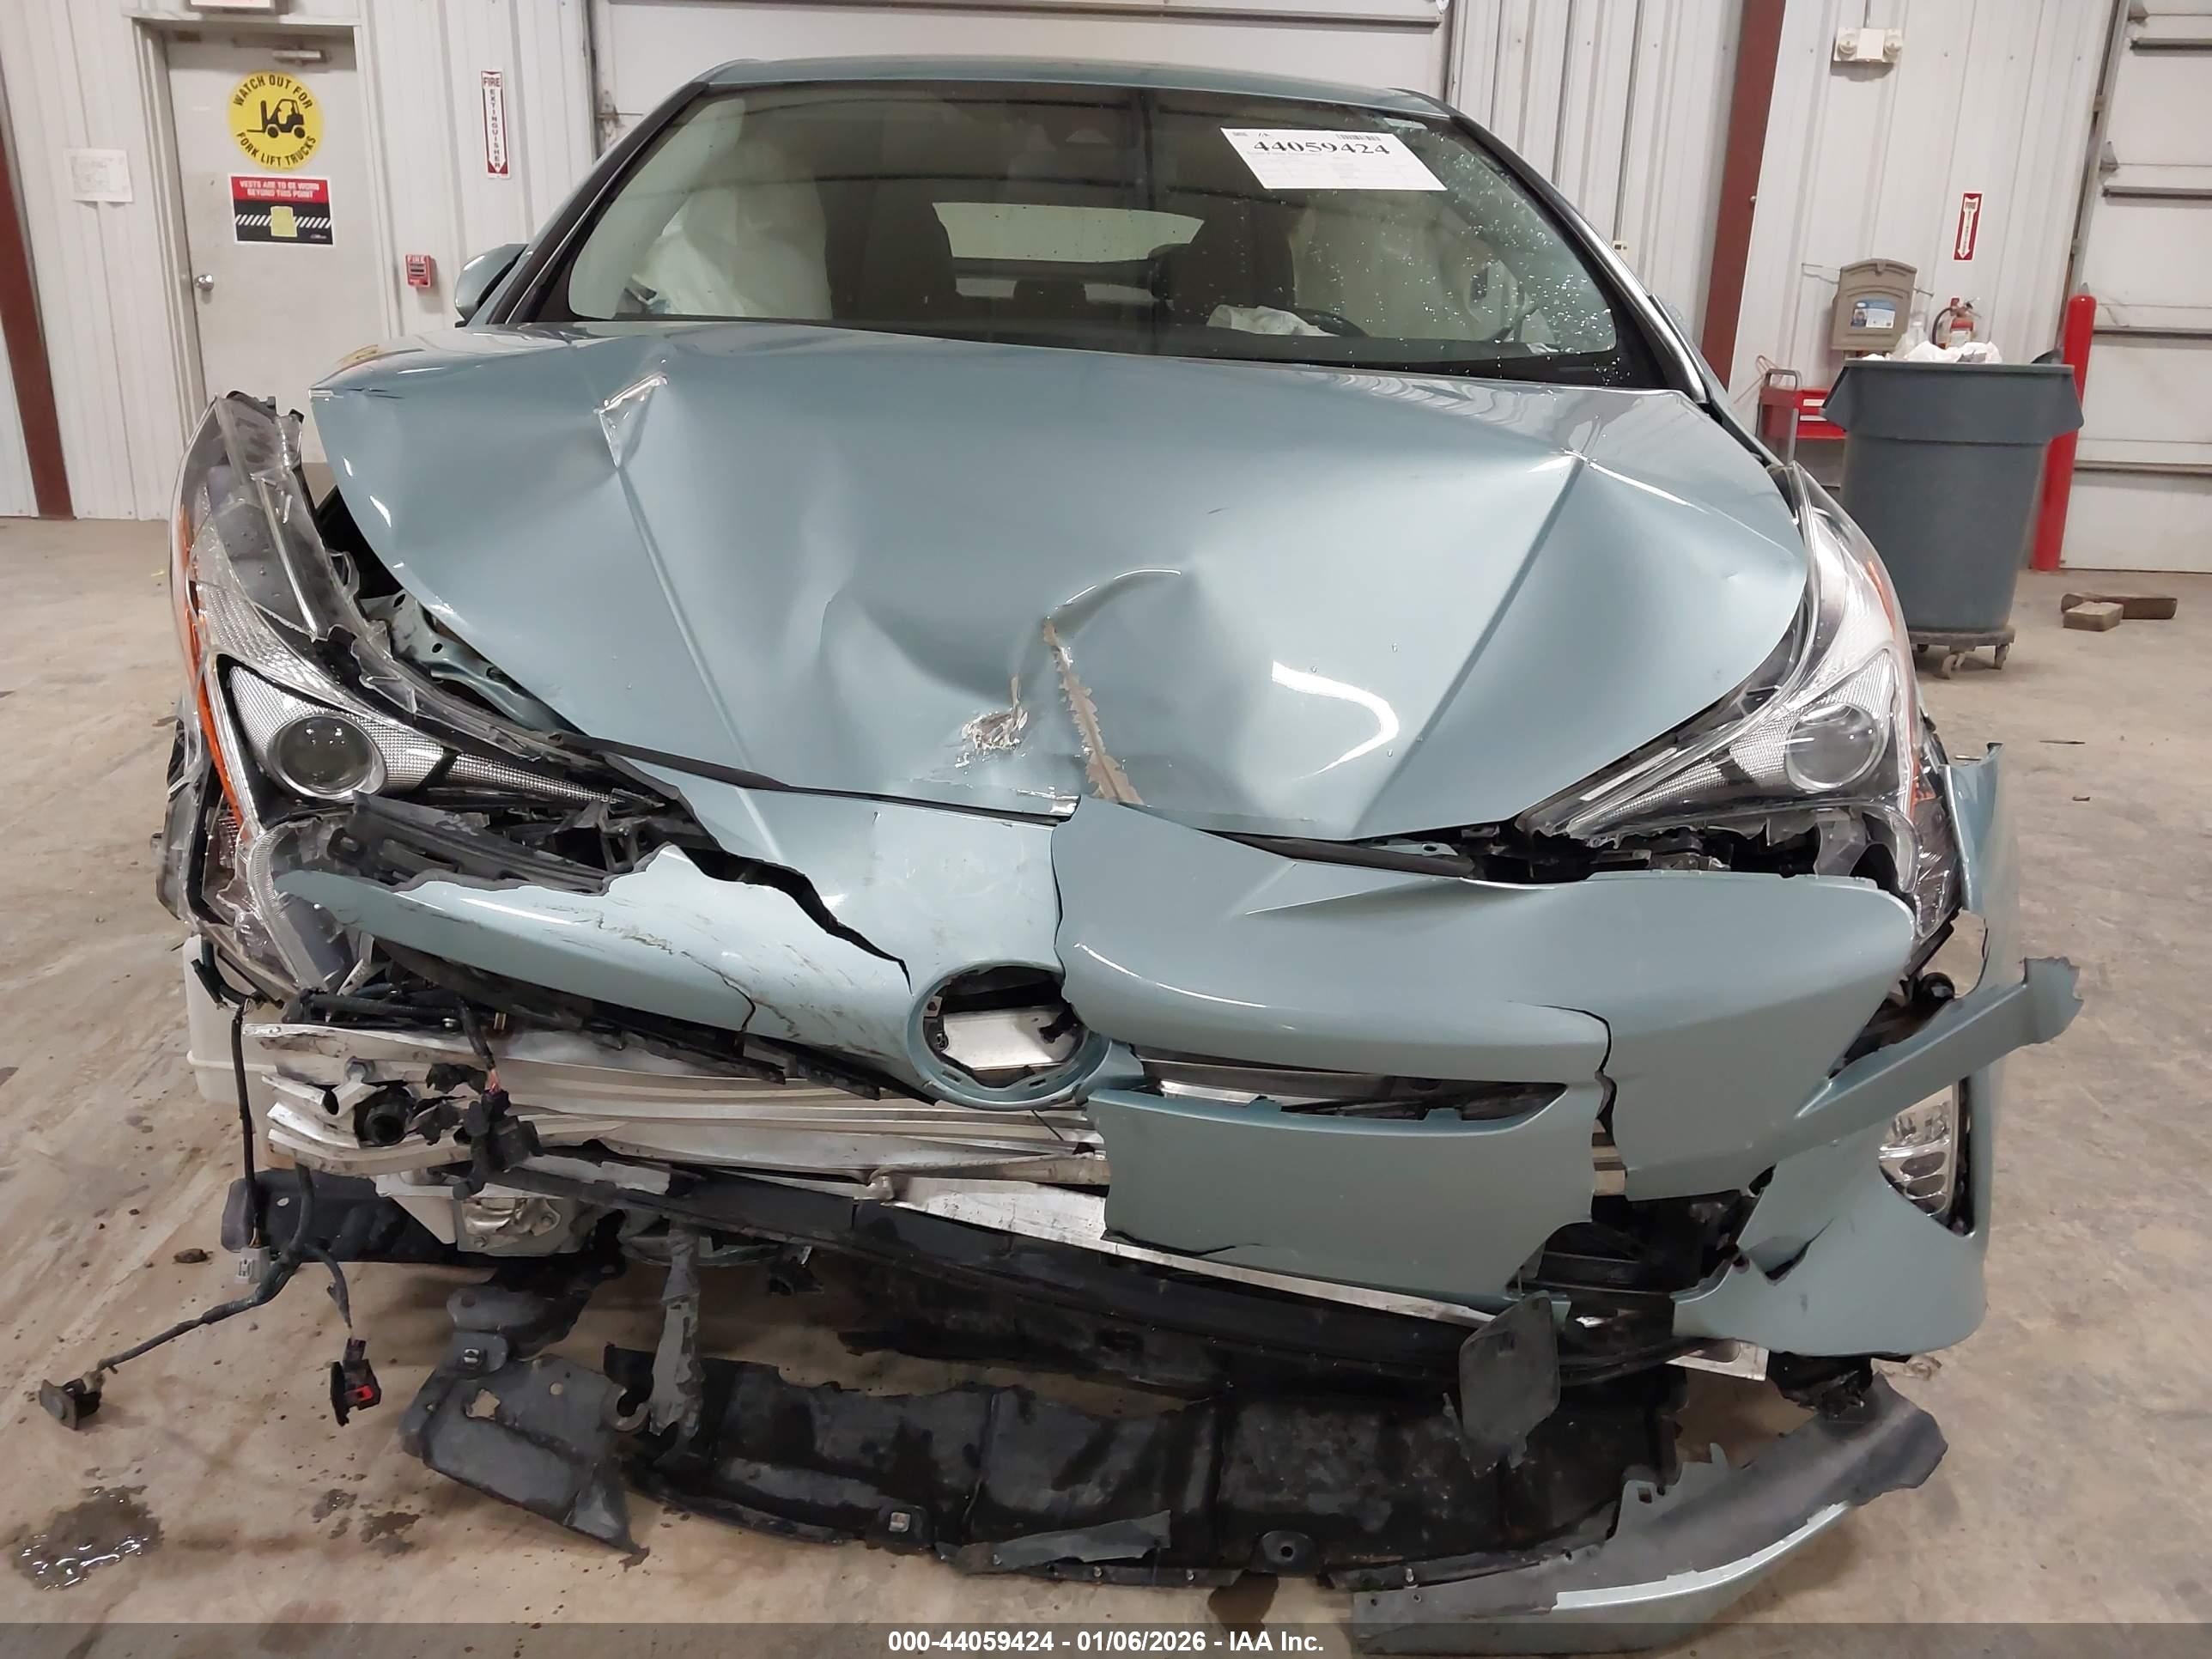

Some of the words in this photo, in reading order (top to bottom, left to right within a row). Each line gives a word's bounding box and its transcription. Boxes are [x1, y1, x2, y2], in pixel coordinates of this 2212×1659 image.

[233, 75, 265, 106] WATCH
[269, 74, 292, 89] OUT
[293, 86, 313, 109] FOR
[483, 77, 500, 88] FIRE
[489, 88, 501, 168] EXTINGUISHER
[236, 131, 259, 158] FORK
[260, 153, 282, 167] LIFT
[284, 136, 316, 166] TRUCKS
[1254, 141, 1390, 155] 44059424
